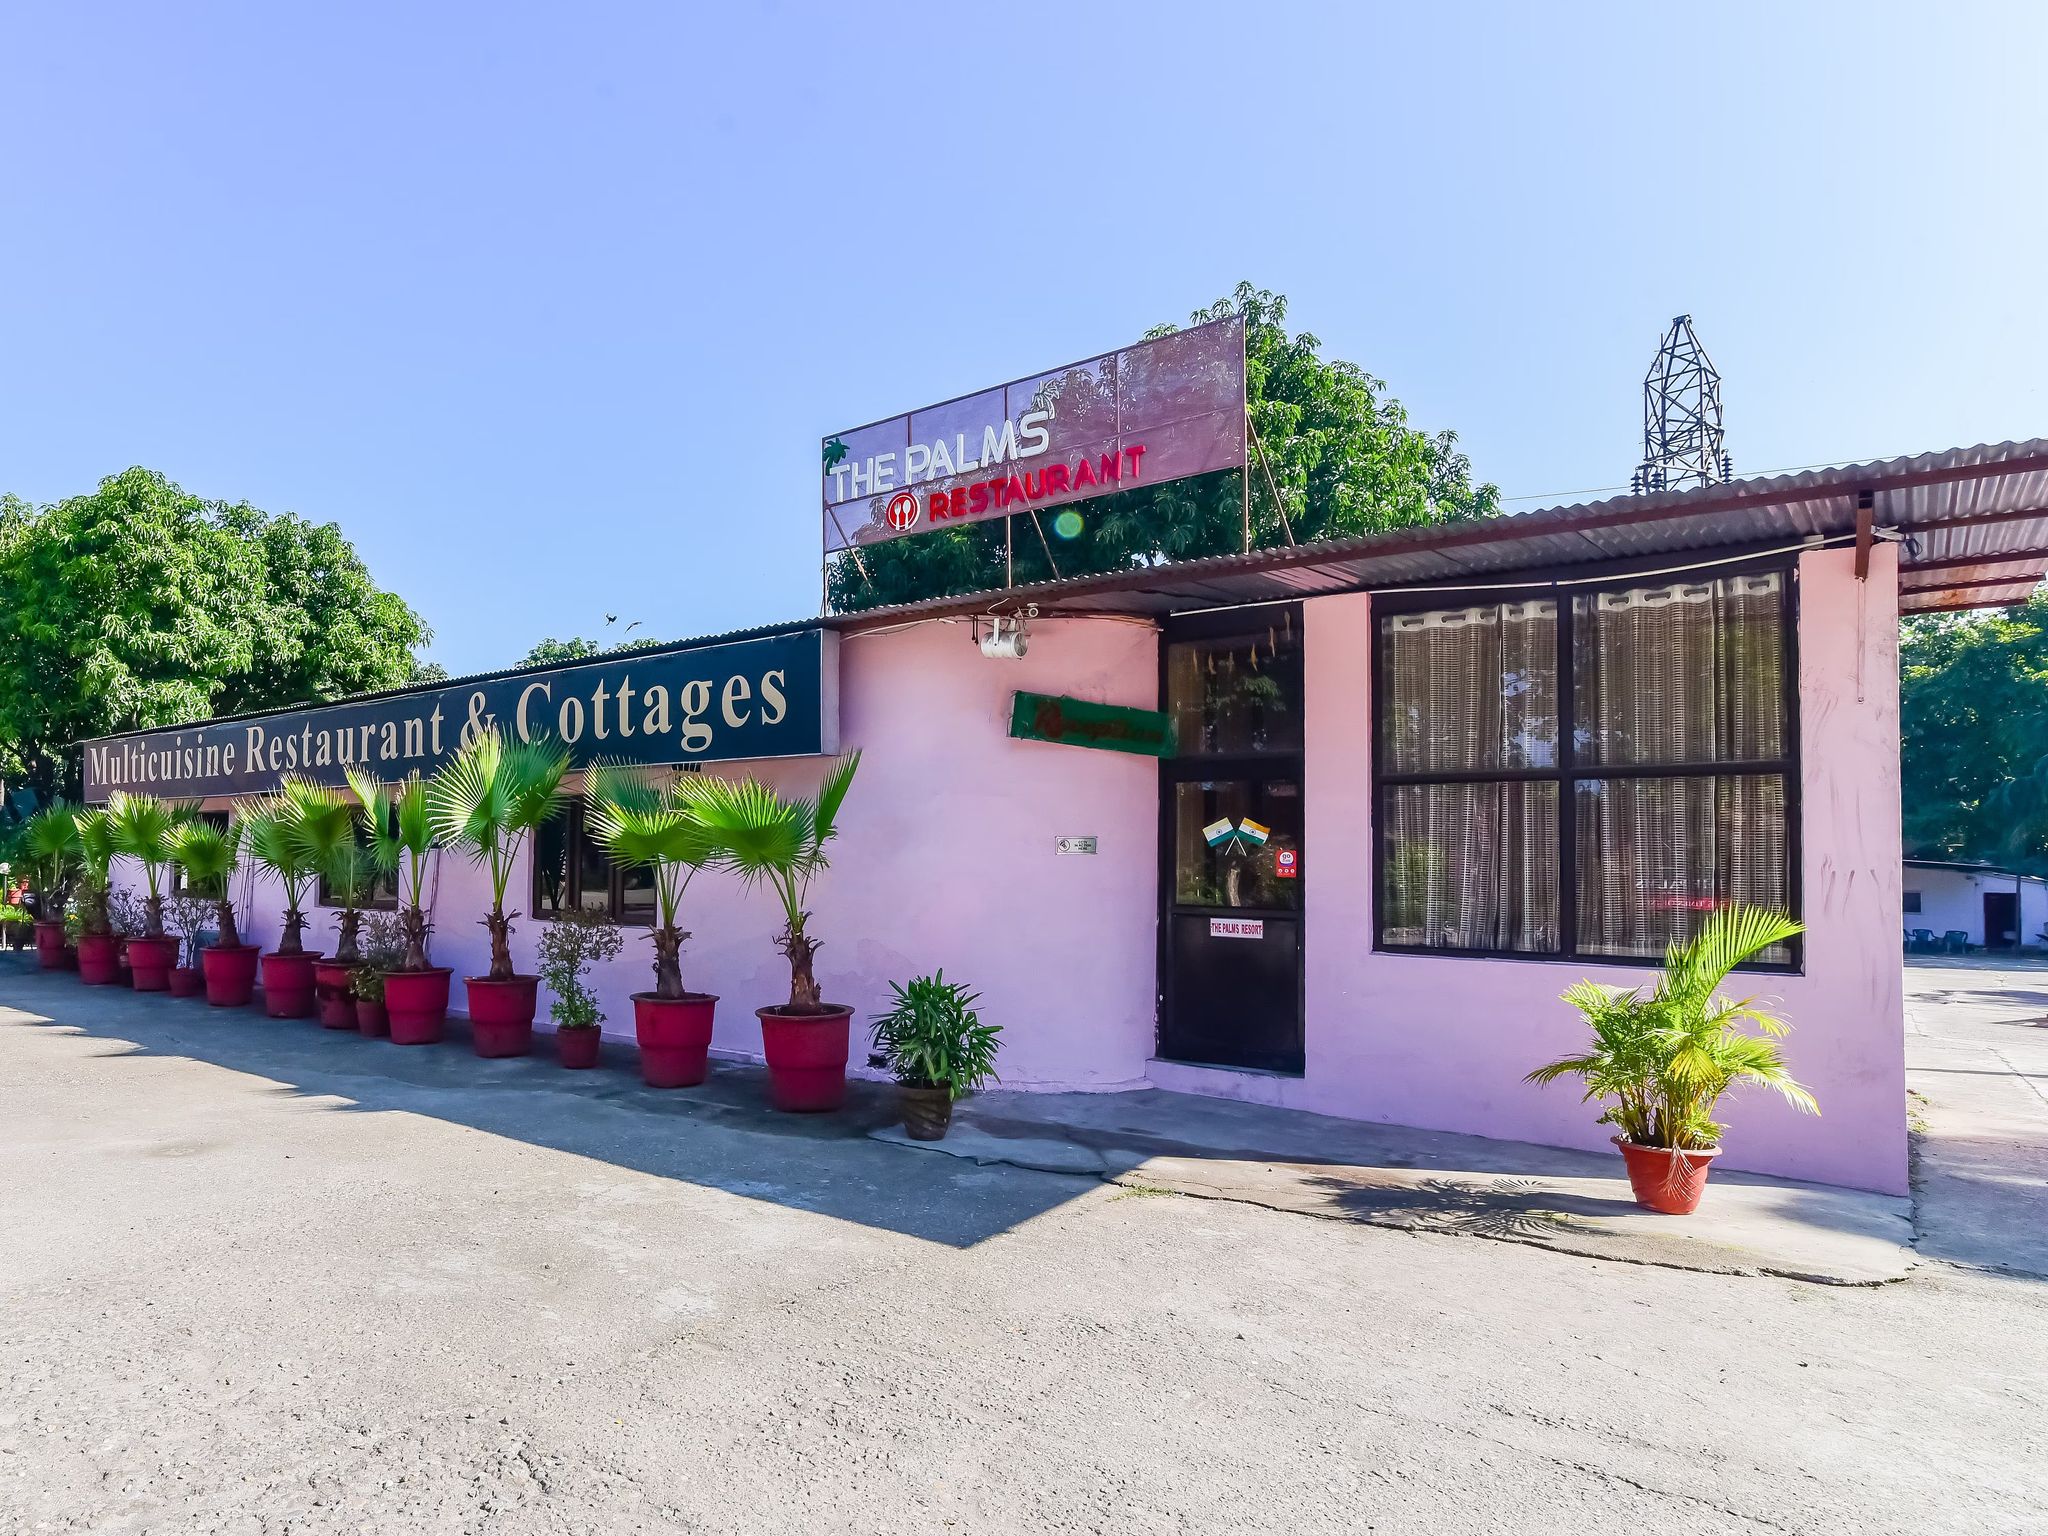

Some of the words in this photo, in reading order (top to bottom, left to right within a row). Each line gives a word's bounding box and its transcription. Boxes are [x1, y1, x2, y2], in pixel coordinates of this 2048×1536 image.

[829, 452, 896, 502] THE
[905, 410, 1050, 486] PALMS
[929, 445, 1147, 522] RESTAURANT
[90, 733, 235, 786] Multicuisine
[245, 703, 444, 773] Restaurant
[460, 691, 496, 762] &
[516, 669, 787, 752] Cottages
[1211, 923, 1222, 933] THE
[1223, 923, 1240, 934] PALMS
[1241, 924, 1262, 935] RESORT
